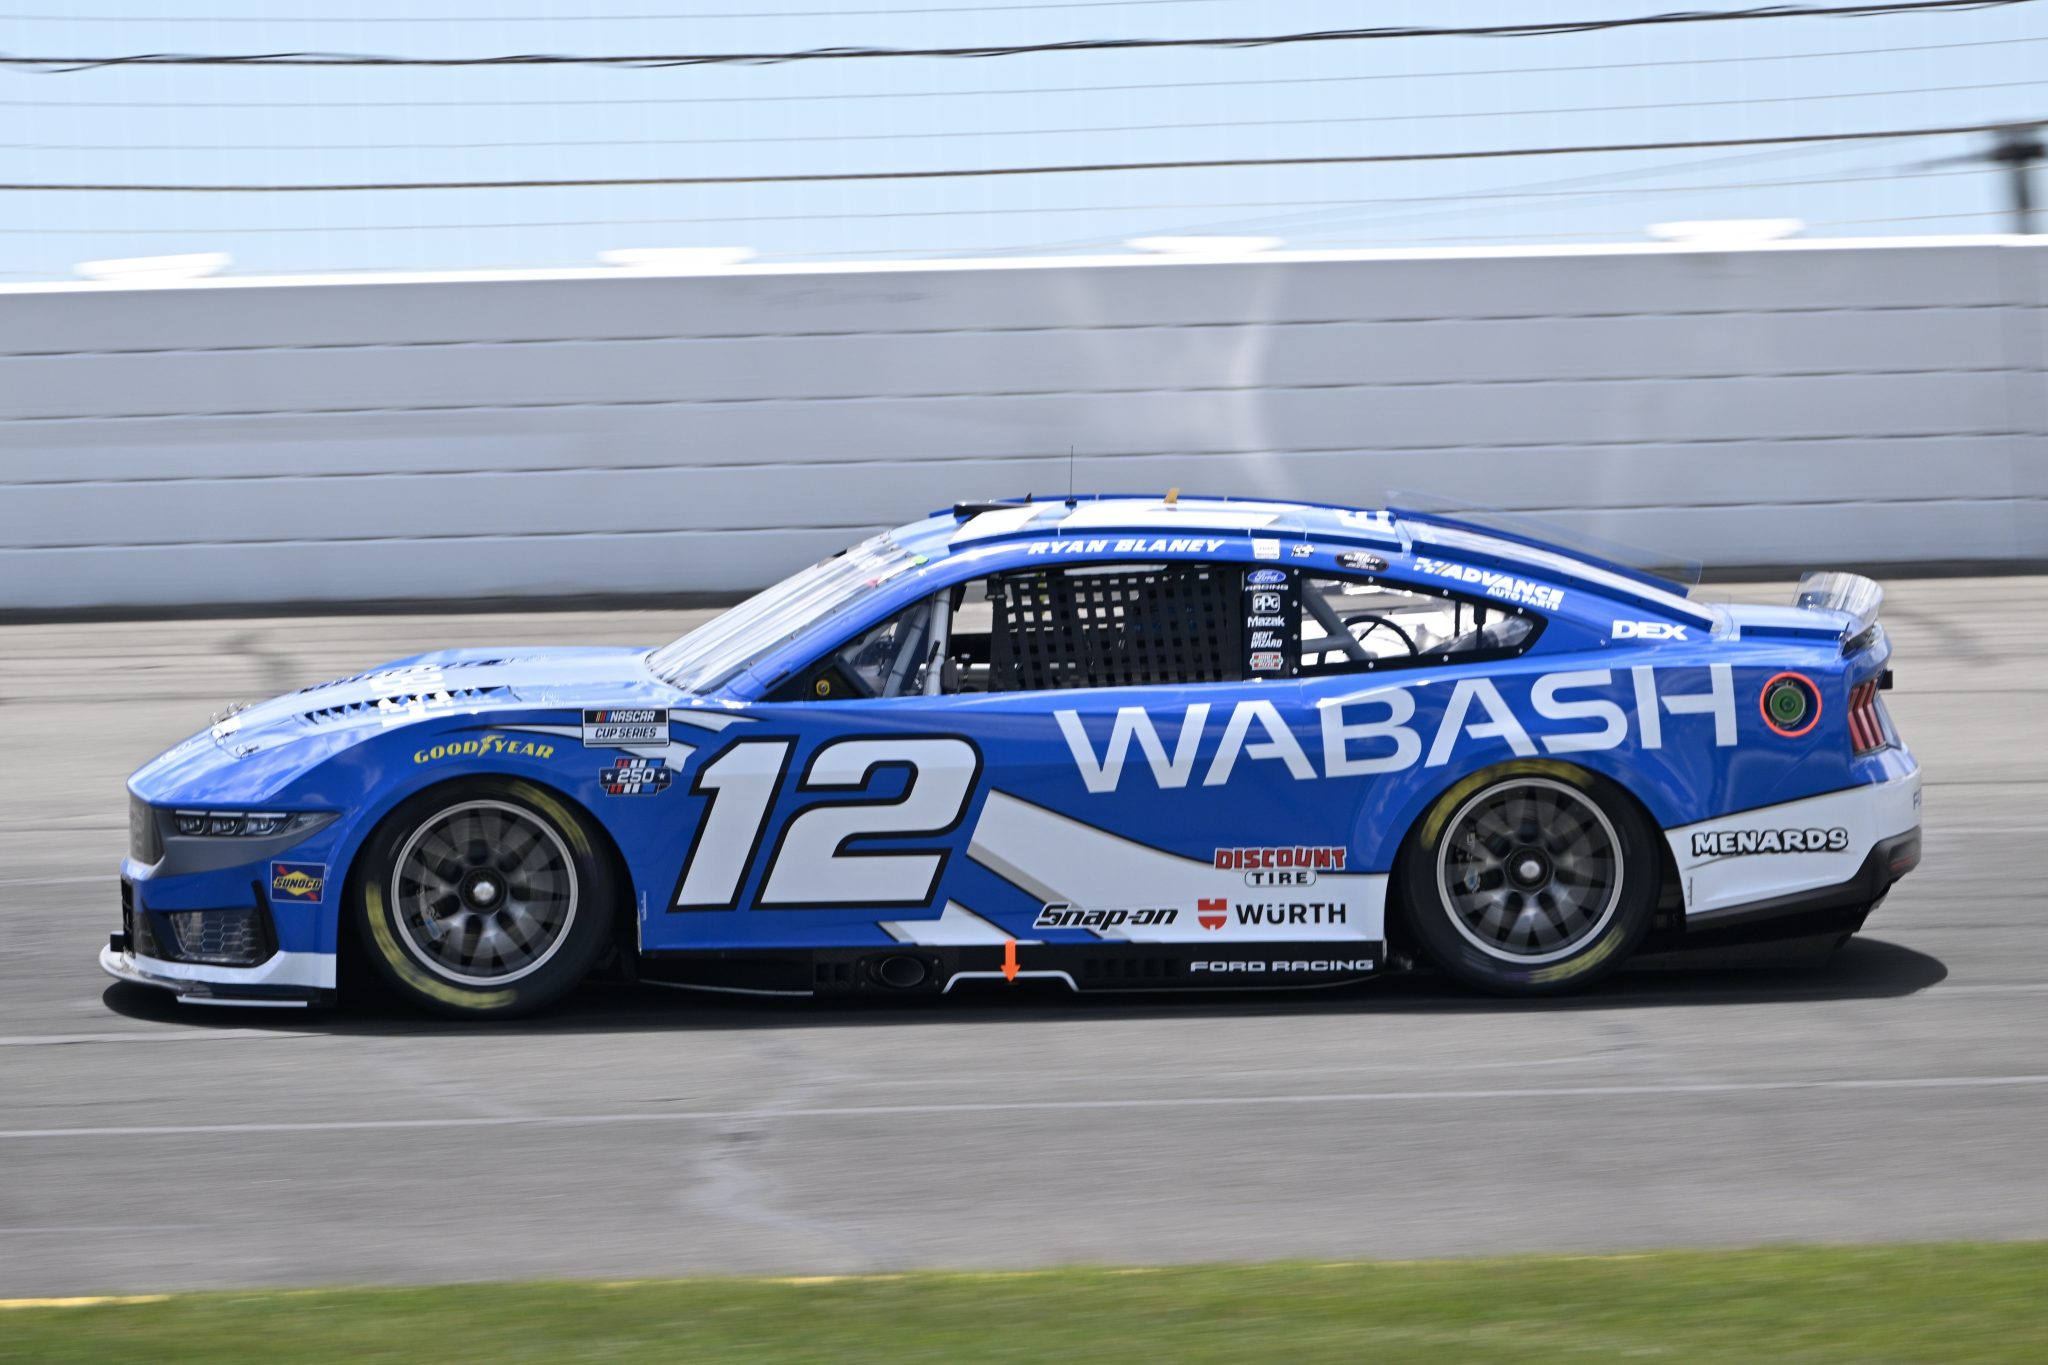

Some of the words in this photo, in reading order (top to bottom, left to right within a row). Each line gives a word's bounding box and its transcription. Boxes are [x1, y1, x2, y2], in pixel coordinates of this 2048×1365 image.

[1027, 540, 1108, 555] RYAN
[1114, 539, 1225, 553] BLANEY
[1253, 570, 1280, 582] Ford
[1441, 564, 1565, 603] ADVANCE
[1254, 594, 1279, 611] PPG
[1486, 587, 1520, 601] AUTO
[1521, 595, 1560, 611] PARTS
[1247, 616, 1285, 628] Mazak
[1252, 631, 1274, 641] DENT
[1611, 620, 1688, 641] DEX
[1250, 639, 1282, 649] WIZARD
[610, 710, 656, 723] NASCAR
[595, 728, 617, 738] CUP
[618, 727, 657, 738] SERIES
[1053, 663, 1738, 793] WABASH
[413, 735, 554, 764] GOODYEAR
[617, 768, 656, 784] 250
[667, 733, 985, 913] 12
[1692, 828, 1849, 857] MENARDS
[1215, 846, 1347, 870] DISCOUNT
[273, 876, 322, 891] SUNOCO
[1251, 872, 1309, 885] TIRE
[1034, 902, 1179, 931] Snap-on
[1190, 960, 1266, 972] FORD
[1271, 959, 1374, 971] RACING
